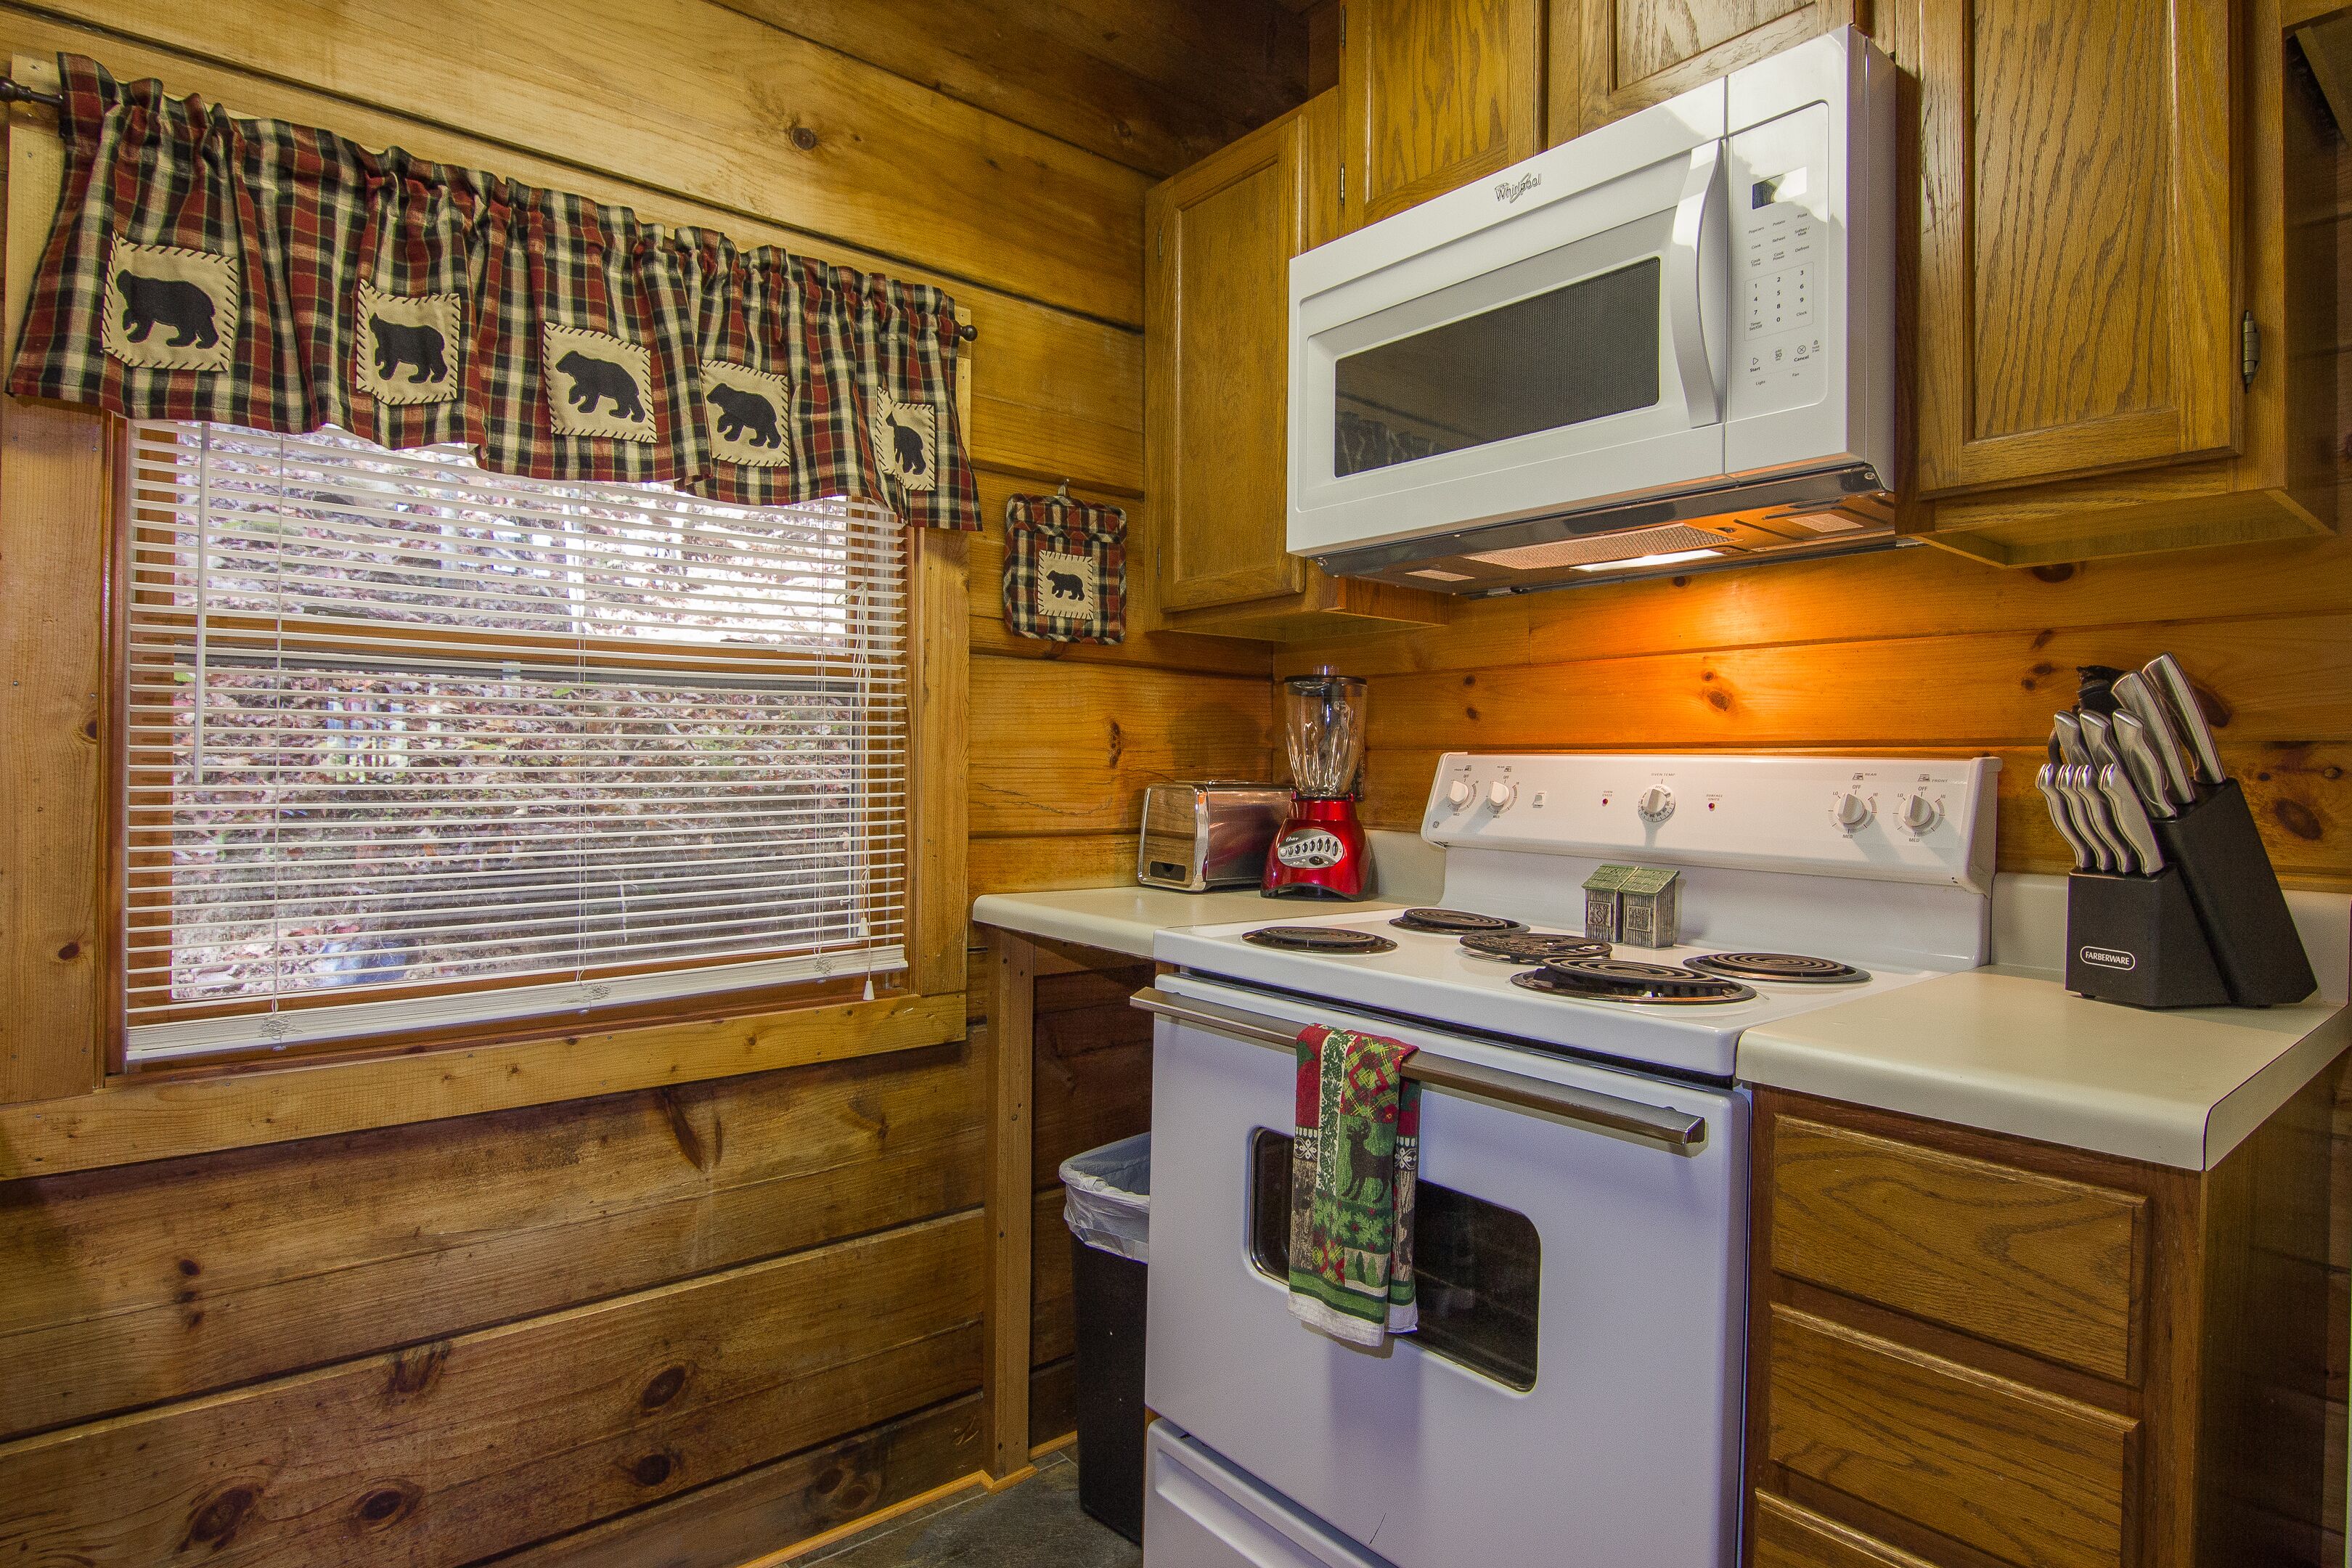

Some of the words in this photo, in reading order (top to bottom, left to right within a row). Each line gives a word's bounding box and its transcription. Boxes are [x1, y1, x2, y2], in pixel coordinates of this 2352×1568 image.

[1495, 173, 1541, 203] Whirlpool
[1596, 910, 1603, 923] S
[2086, 952, 2129, 965] FARBERWARE
